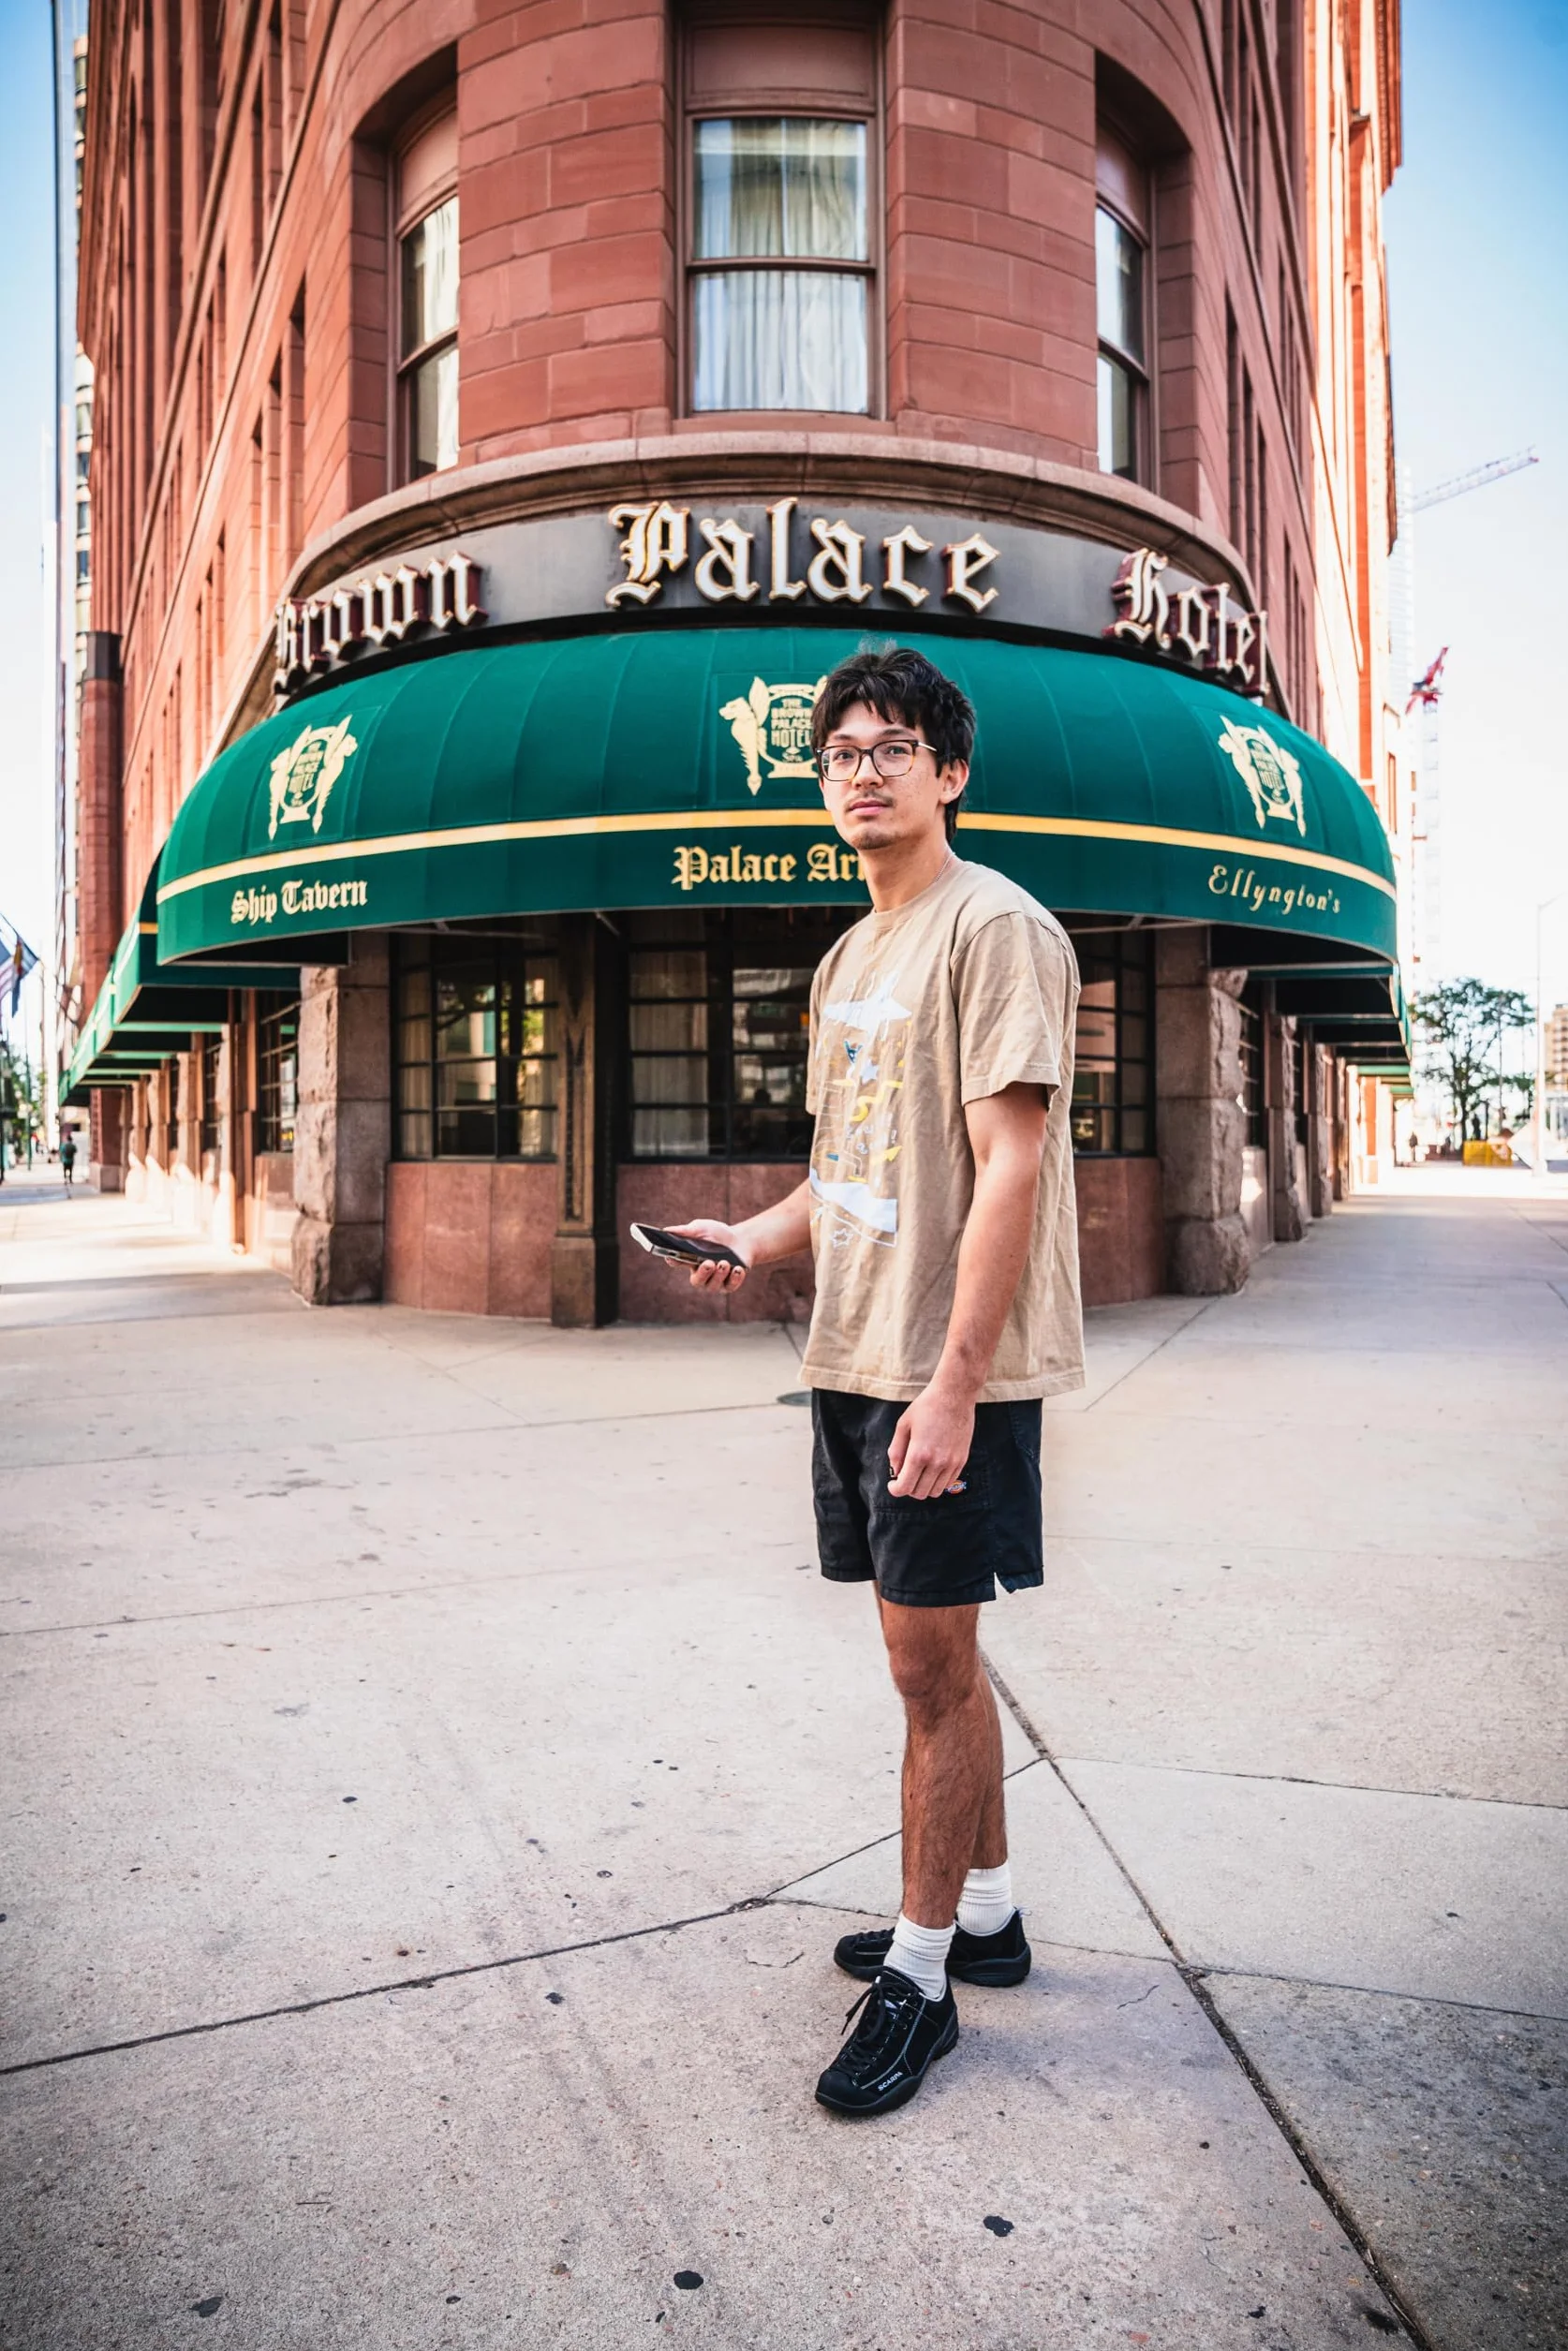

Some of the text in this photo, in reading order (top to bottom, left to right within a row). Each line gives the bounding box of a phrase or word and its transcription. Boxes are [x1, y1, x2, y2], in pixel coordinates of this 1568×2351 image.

[273, 496, 1271, 695] Brown Palace Hotel
[671, 844, 797, 891] Palace
[1207, 864, 1341, 916] Ellyngton's
[230, 879, 368, 926] Ship Tavern
[878, 2072, 903, 2091] SCARPA
